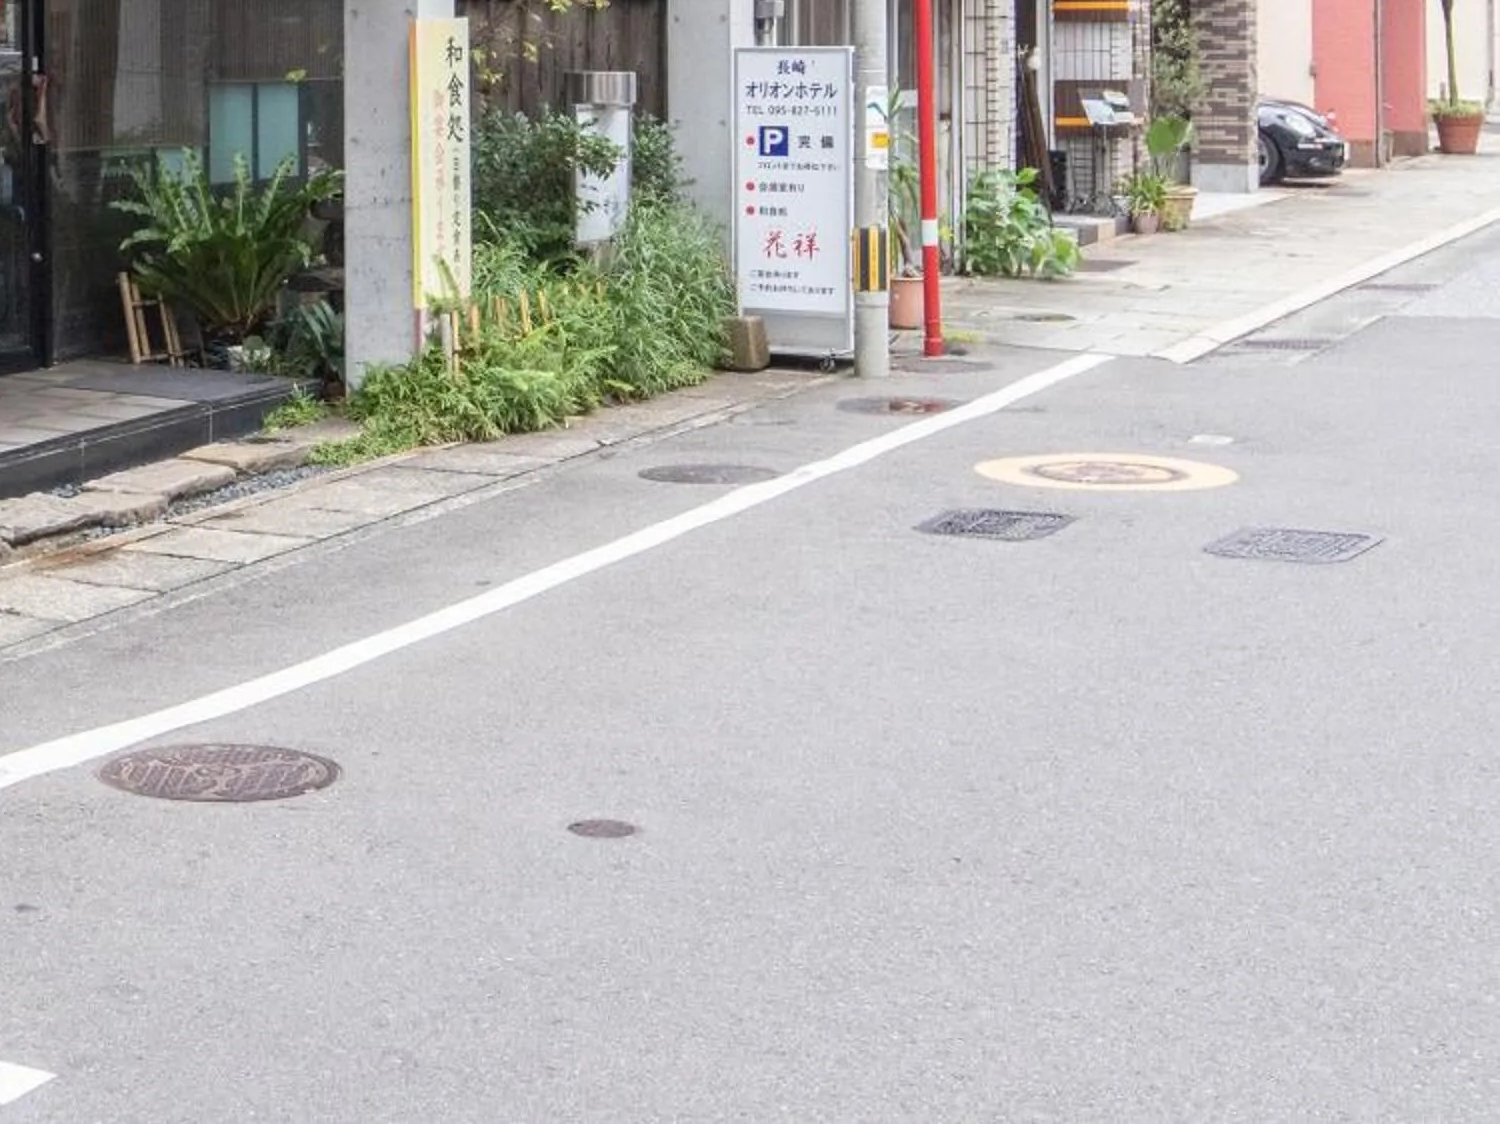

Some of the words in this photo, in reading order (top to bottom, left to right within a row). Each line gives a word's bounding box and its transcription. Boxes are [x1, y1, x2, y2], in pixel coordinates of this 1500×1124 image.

[777, 59, 805, 75] 長崎
[445, 35, 464, 143] 和食処
[745, 81, 838, 100] オリオンホテル
[746, 105, 764, 116] TEL
[763, 128, 784, 155] P
